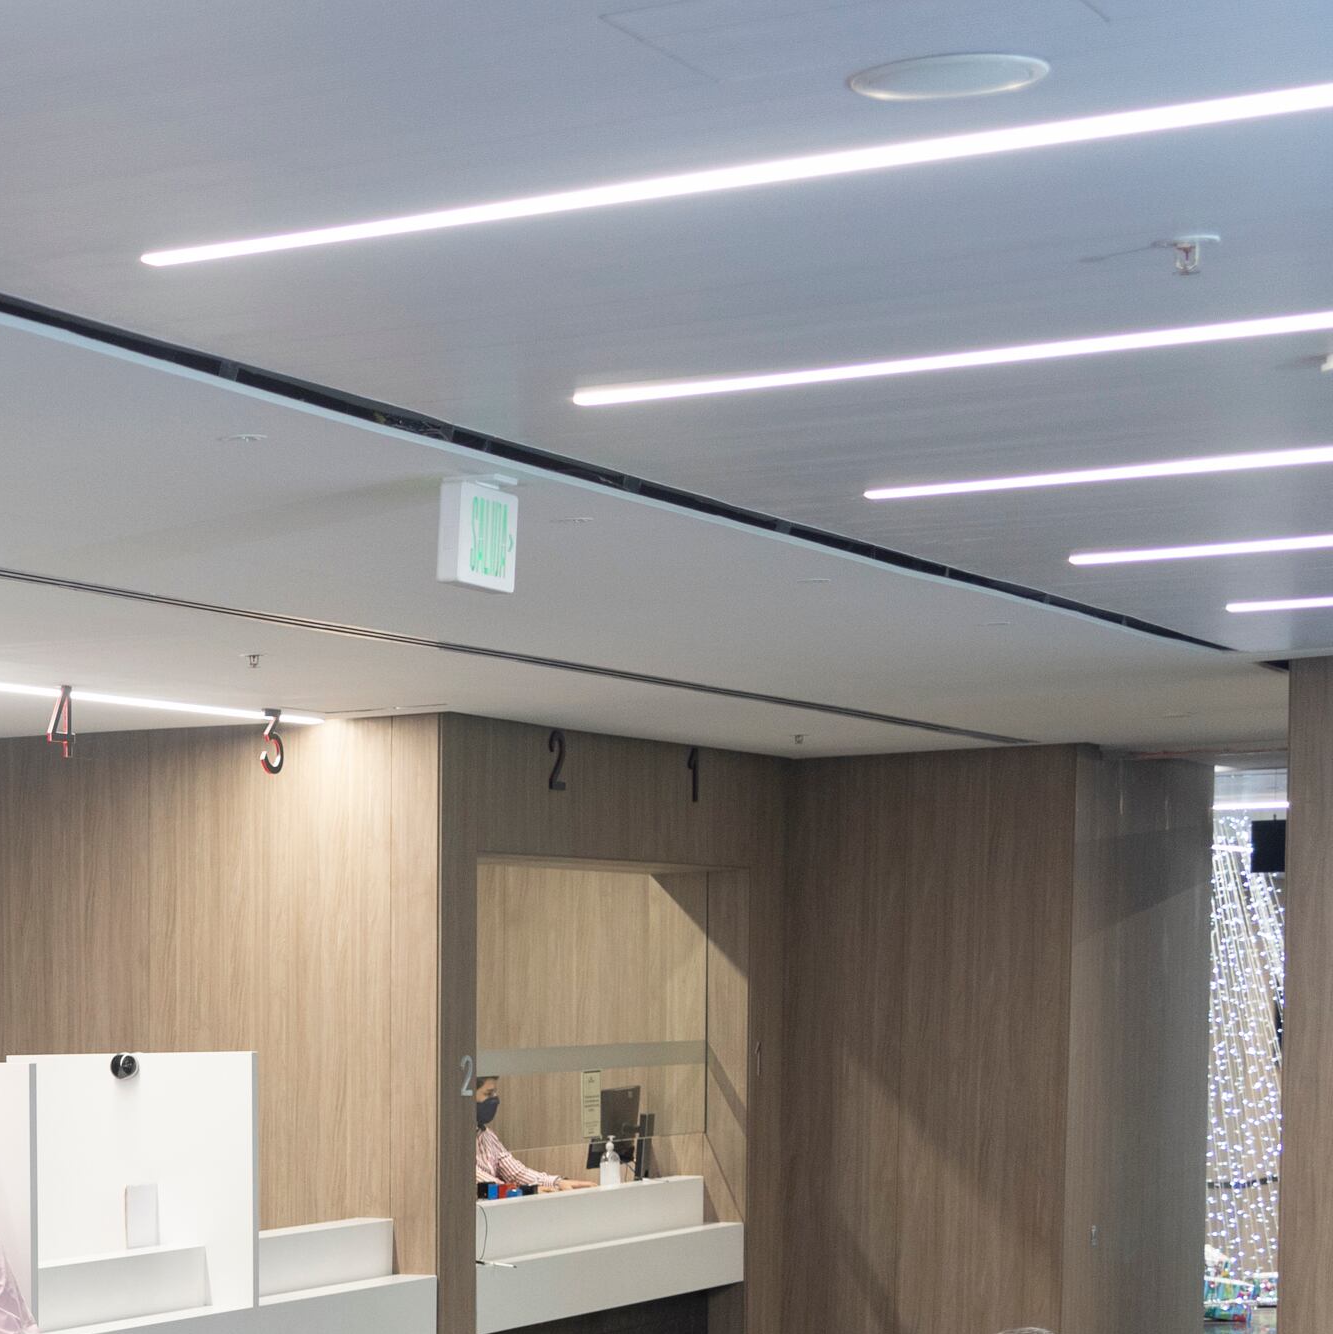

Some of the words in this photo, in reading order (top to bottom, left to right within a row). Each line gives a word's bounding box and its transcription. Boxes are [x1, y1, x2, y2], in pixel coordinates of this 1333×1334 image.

[47, 685, 76, 758] 4
[260, 708, 284, 775] 3
[548, 729, 566, 791] 2
[688, 746, 700, 803] 1
[461, 1055, 473, 1096] 2
